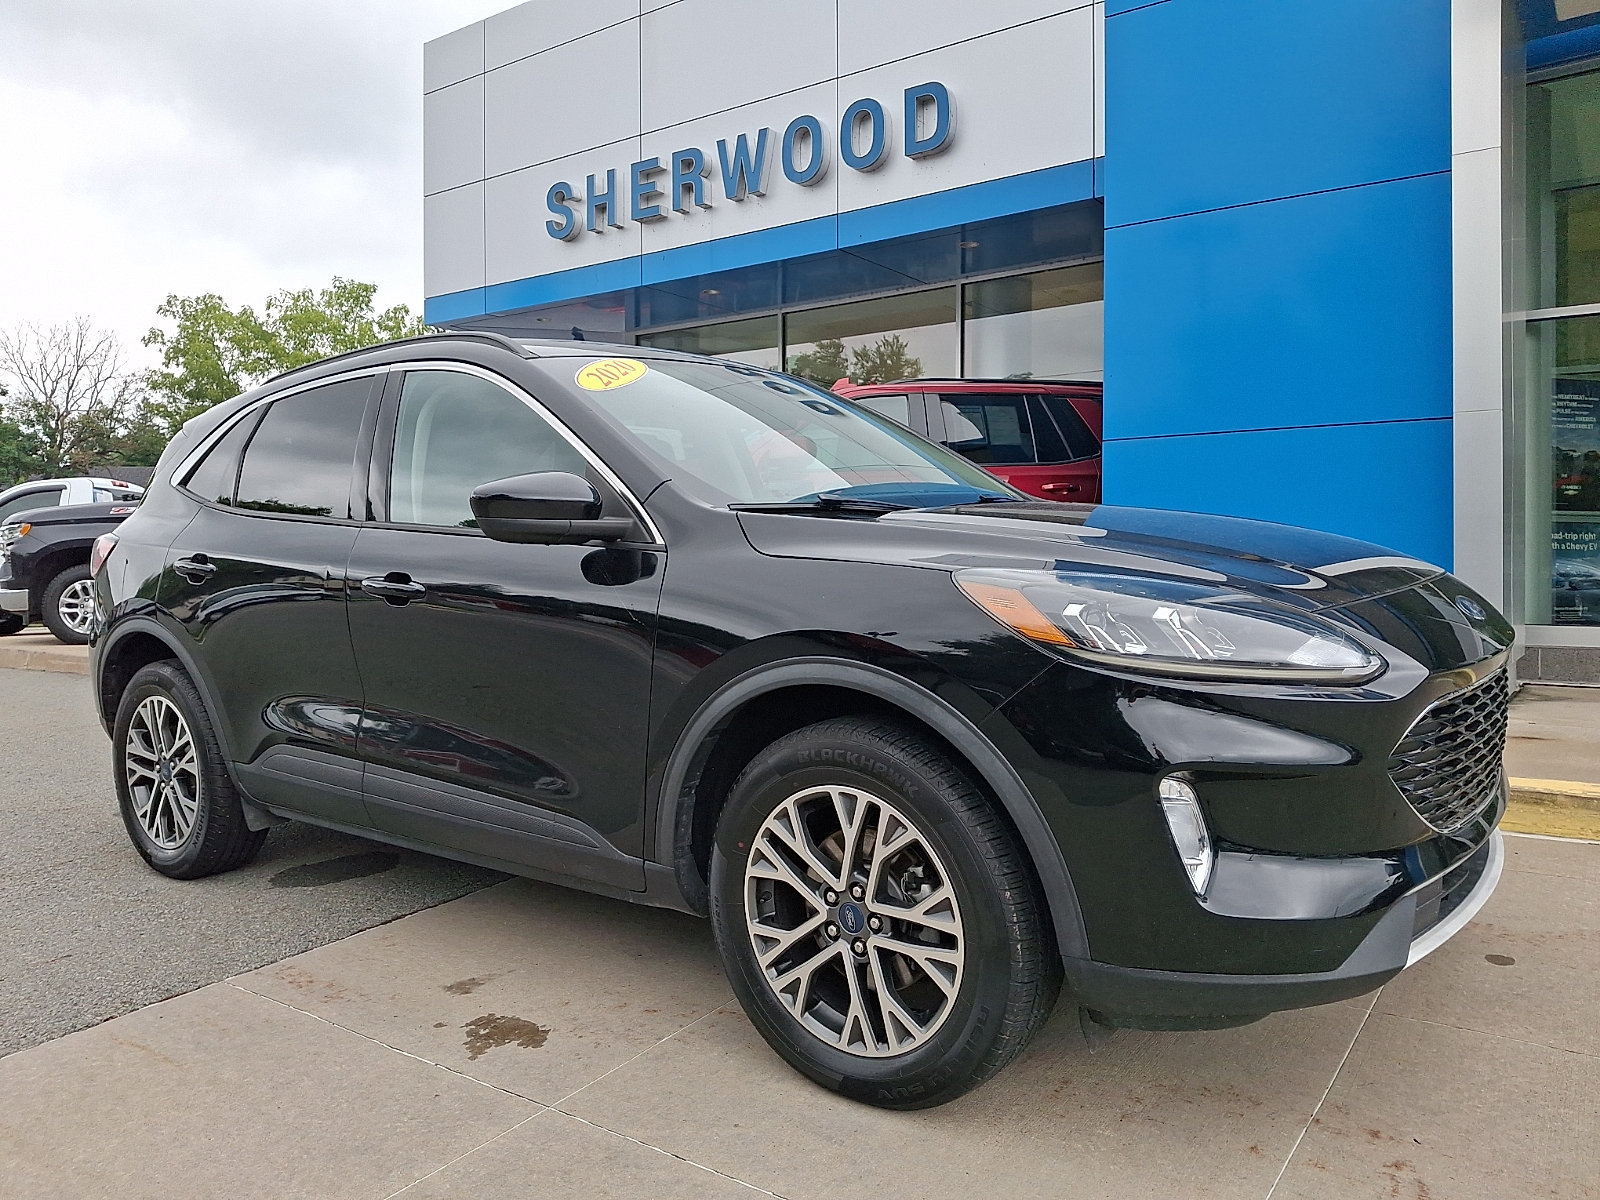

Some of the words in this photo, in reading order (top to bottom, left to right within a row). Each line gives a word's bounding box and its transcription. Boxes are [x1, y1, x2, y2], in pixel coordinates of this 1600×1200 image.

[546, 82, 955, 241] SHERWOOD
[586, 360, 637, 387] 2020
[1566, 542, 1588, 551] Chevy
[1589, 542, 1598, 550] EV
[1580, 532, 1596, 540] right
[798, 748, 919, 798] BLACKHAWK
